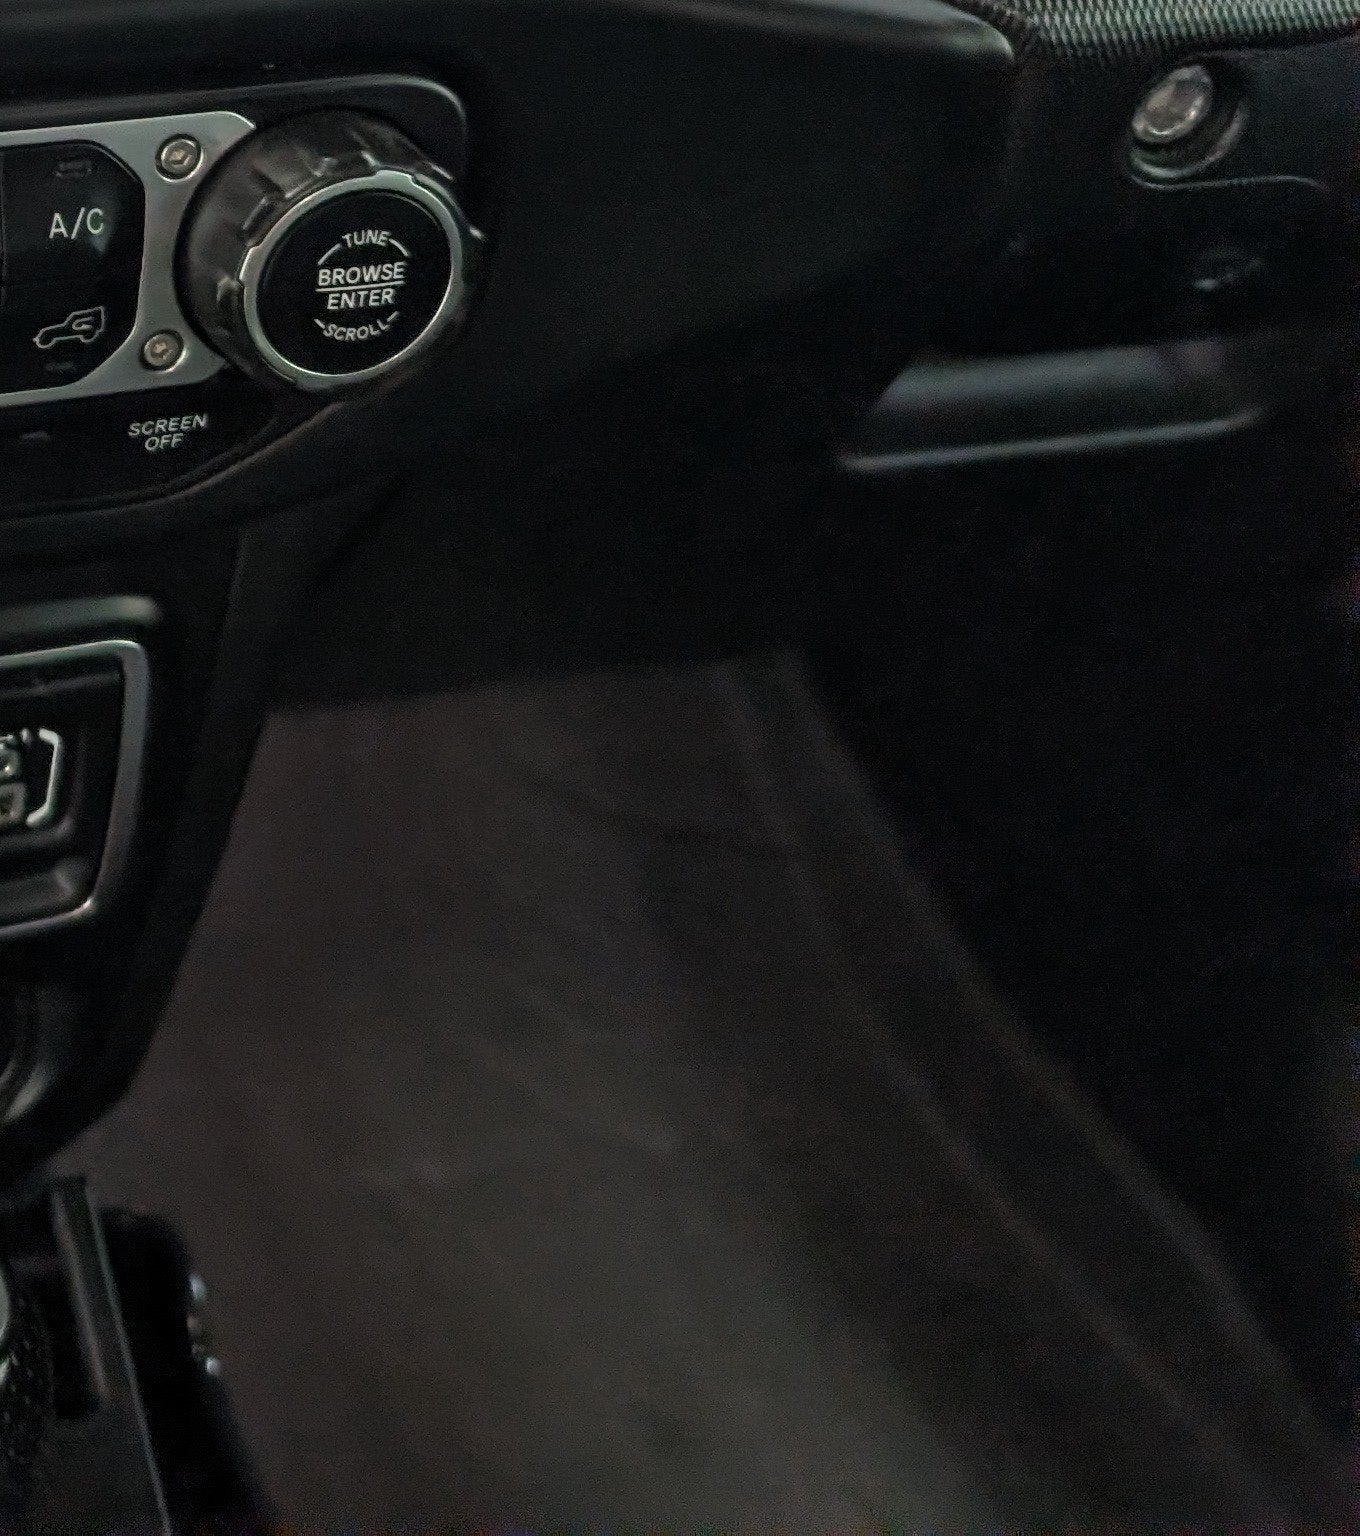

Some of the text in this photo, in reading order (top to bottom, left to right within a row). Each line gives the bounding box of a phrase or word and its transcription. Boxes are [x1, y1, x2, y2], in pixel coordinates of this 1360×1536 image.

[49, 209, 104, 241] A/C
[342, 230, 389, 248] TUNE
[317, 263, 404, 286] BROWSE
[326, 287, 394, 310] ENTER
[322, 319, 389, 342] SCROLL
[128, 415, 208, 438] SCREEN
[144, 433, 183, 452] OFF
